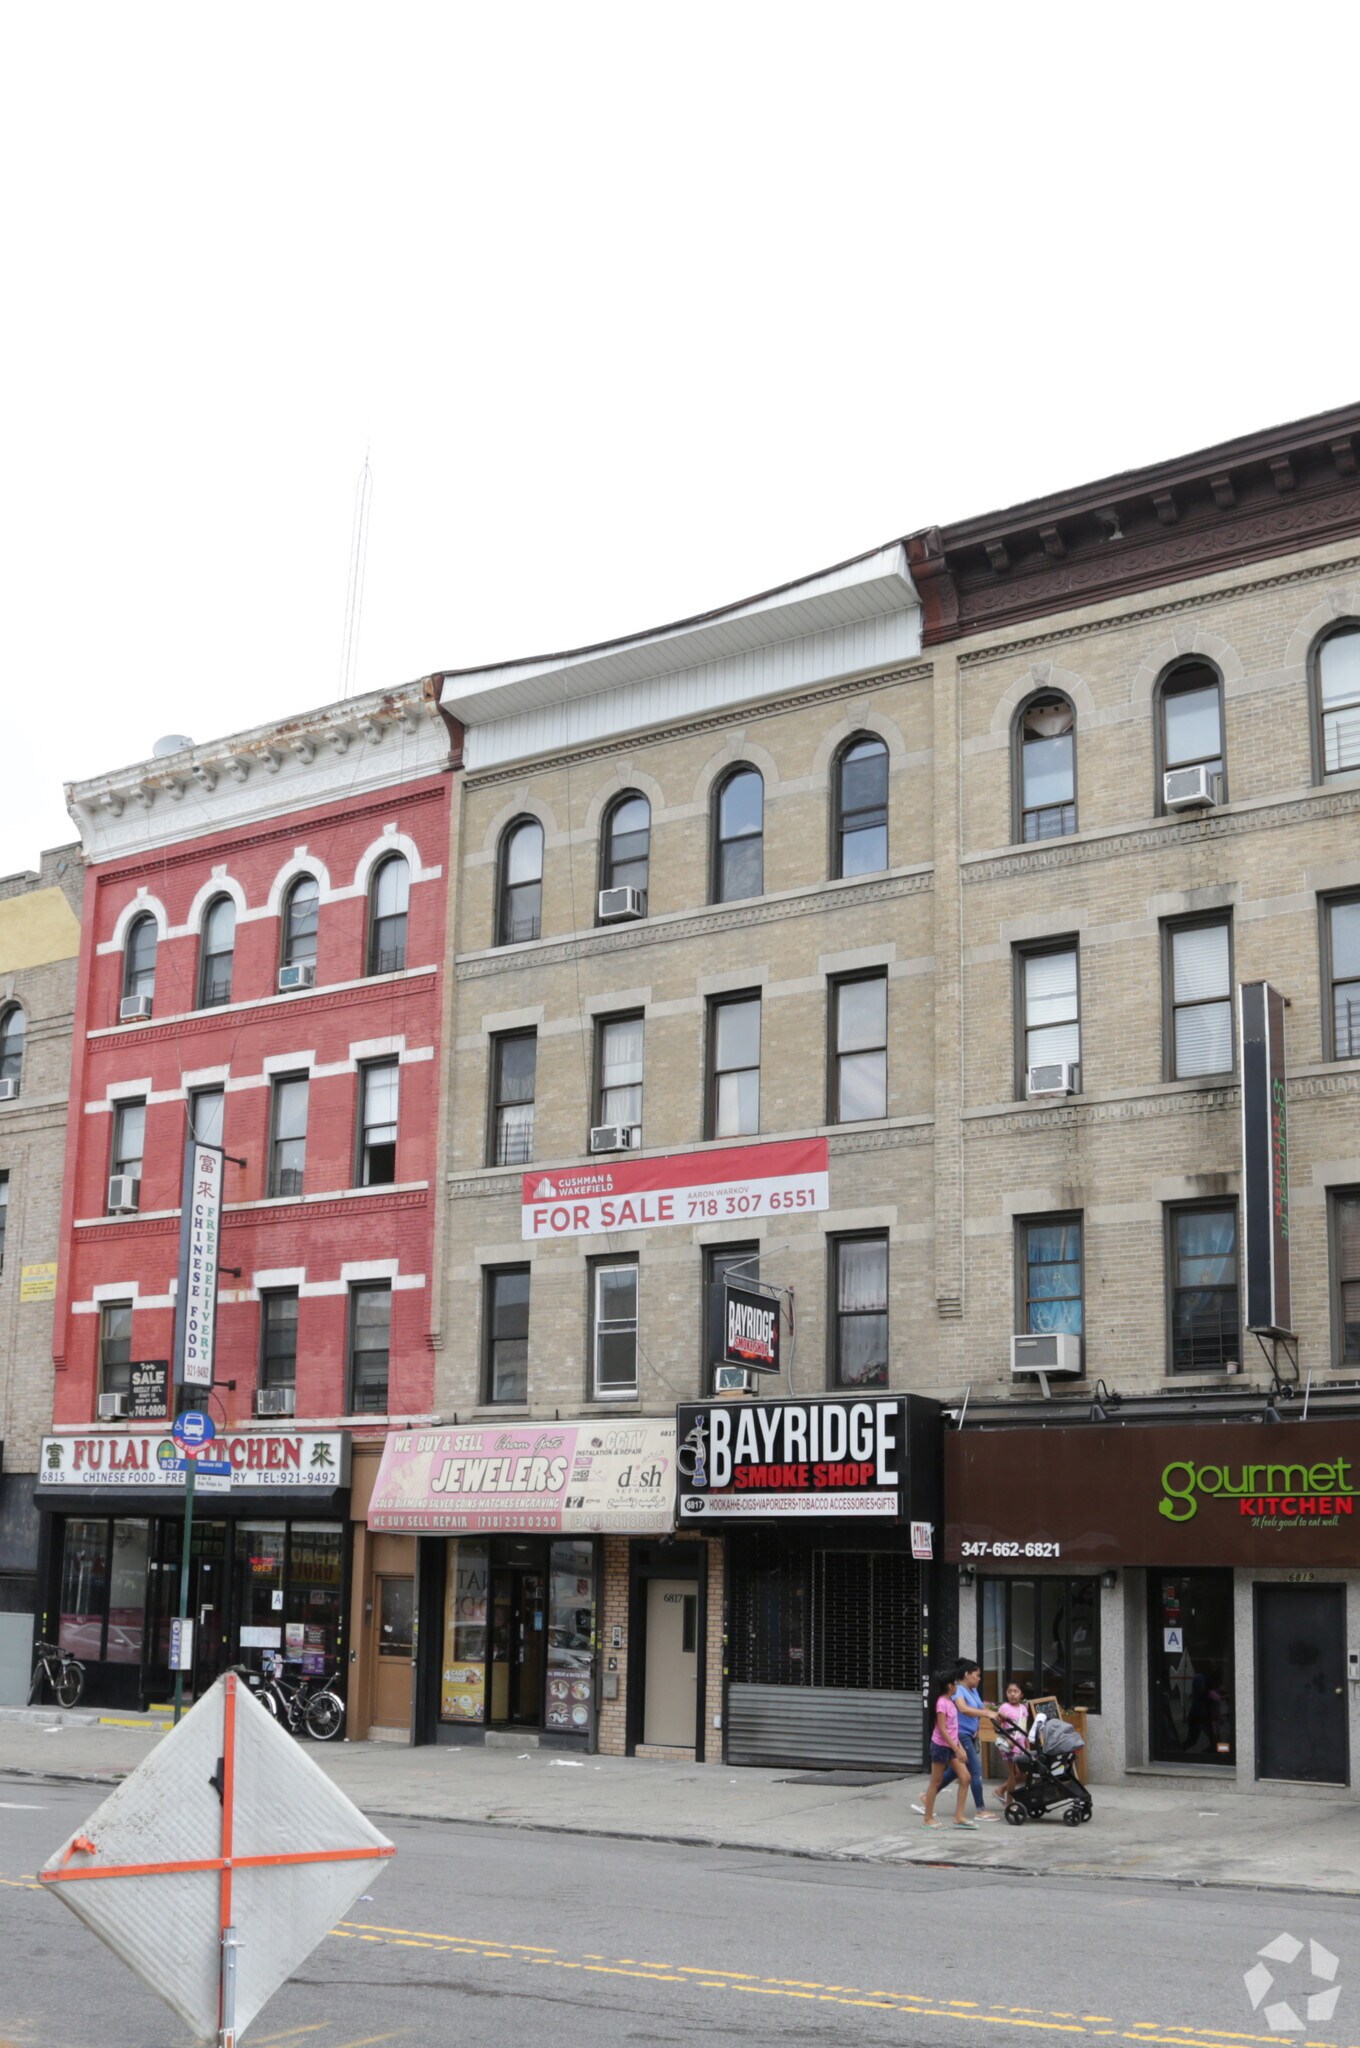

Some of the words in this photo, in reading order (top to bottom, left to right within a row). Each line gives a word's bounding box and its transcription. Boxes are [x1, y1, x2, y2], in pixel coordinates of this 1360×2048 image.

[558, 1175, 604, 1187] CUSHMAN
[606, 1173, 613, 1182] &
[559, 1182, 613, 1196] WAKEFIELD
[687, 1191, 714, 1199] AARON
[716, 1187, 749, 1196] WARKOV
[687, 1199, 718, 1218] 718
[725, 1194, 762, 1214] 307
[769, 1188, 815, 1210] 6551
[533, 1205, 590, 1234] FOR
[601, 1195, 675, 1227] SALE
[205, 1207, 216, 1255] FREE
[191, 1204, 204, 1297] CHINESE
[200, 1262, 214, 1361] DELIVERY
[187, 1306, 198, 1358] FOOD
[728, 1300, 775, 1357] BAYRIDGE
[735, 1336, 753, 1353] SMOKE
[753, 1340, 769, 1356] SHOP
[132, 1371, 165, 1385] SALE
[135, 1405, 166, 1416] 745-0909
[394, 1436, 413, 1453] WE
[416, 1435, 442, 1452] BUY
[441, 1435, 452, 1452] &
[454, 1434, 483, 1452] SELL
[605, 1430, 647, 1450] CCTV
[710, 1402, 899, 1487] BAYRIDGE
[46, 1442, 64, 1469] 富
[72, 1440, 104, 1470] FU
[108, 1439, 150, 1470] LAI
[203, 1437, 303, 1470] ITCHEN
[310, 1441, 335, 1468] 來
[161, 1459, 181, 1469] B37
[42, 1471, 65, 1482] 6815
[83, 1472, 125, 1483] CHINESE
[128, 1472, 156, 1483] FOOD
[165, 1472, 184, 1484] FRE
[257, 1472, 336, 1484] TEL:921-9492
[431, 1456, 568, 1493] JEWELERS
[617, 1464, 663, 1488] dish
[734, 1464, 810, 1489] SMOKE
[812, 1462, 875, 1486] SHOP
[1158, 1456, 1354, 1522] gourmet
[375, 1499, 394, 1508] GOLD
[395, 1499, 428, 1508] DIAMOND
[428, 1499, 454, 1508] SILVER
[455, 1499, 477, 1508] COINS
[478, 1498, 515, 1508] WATCHES
[515, 1498, 560, 1508] ENGRAVING
[686, 1500, 703, 1510] 6817
[1239, 1496, 1354, 1516] KITCHEN
[373, 1516, 385, 1526] WE
[388, 1516, 405, 1526] BUY
[407, 1516, 430, 1527] SELL
[433, 1516, 468, 1527] REPAIR
[1260, 1515, 1277, 1528] feels
[1276, 1515, 1299, 1531] good
[1299, 1516, 1306, 1526] to
[1308, 1517, 1320, 1526] eat
[961, 1541, 1060, 1557] 347-662-6821
[252, 1564, 272, 1572] OPEN
[1289, 1573, 1315, 1582] 6819
[274, 1593, 281, 1604] A
[664, 1593, 683, 1603] 6817
[1168, 1632, 1179, 1646] A
